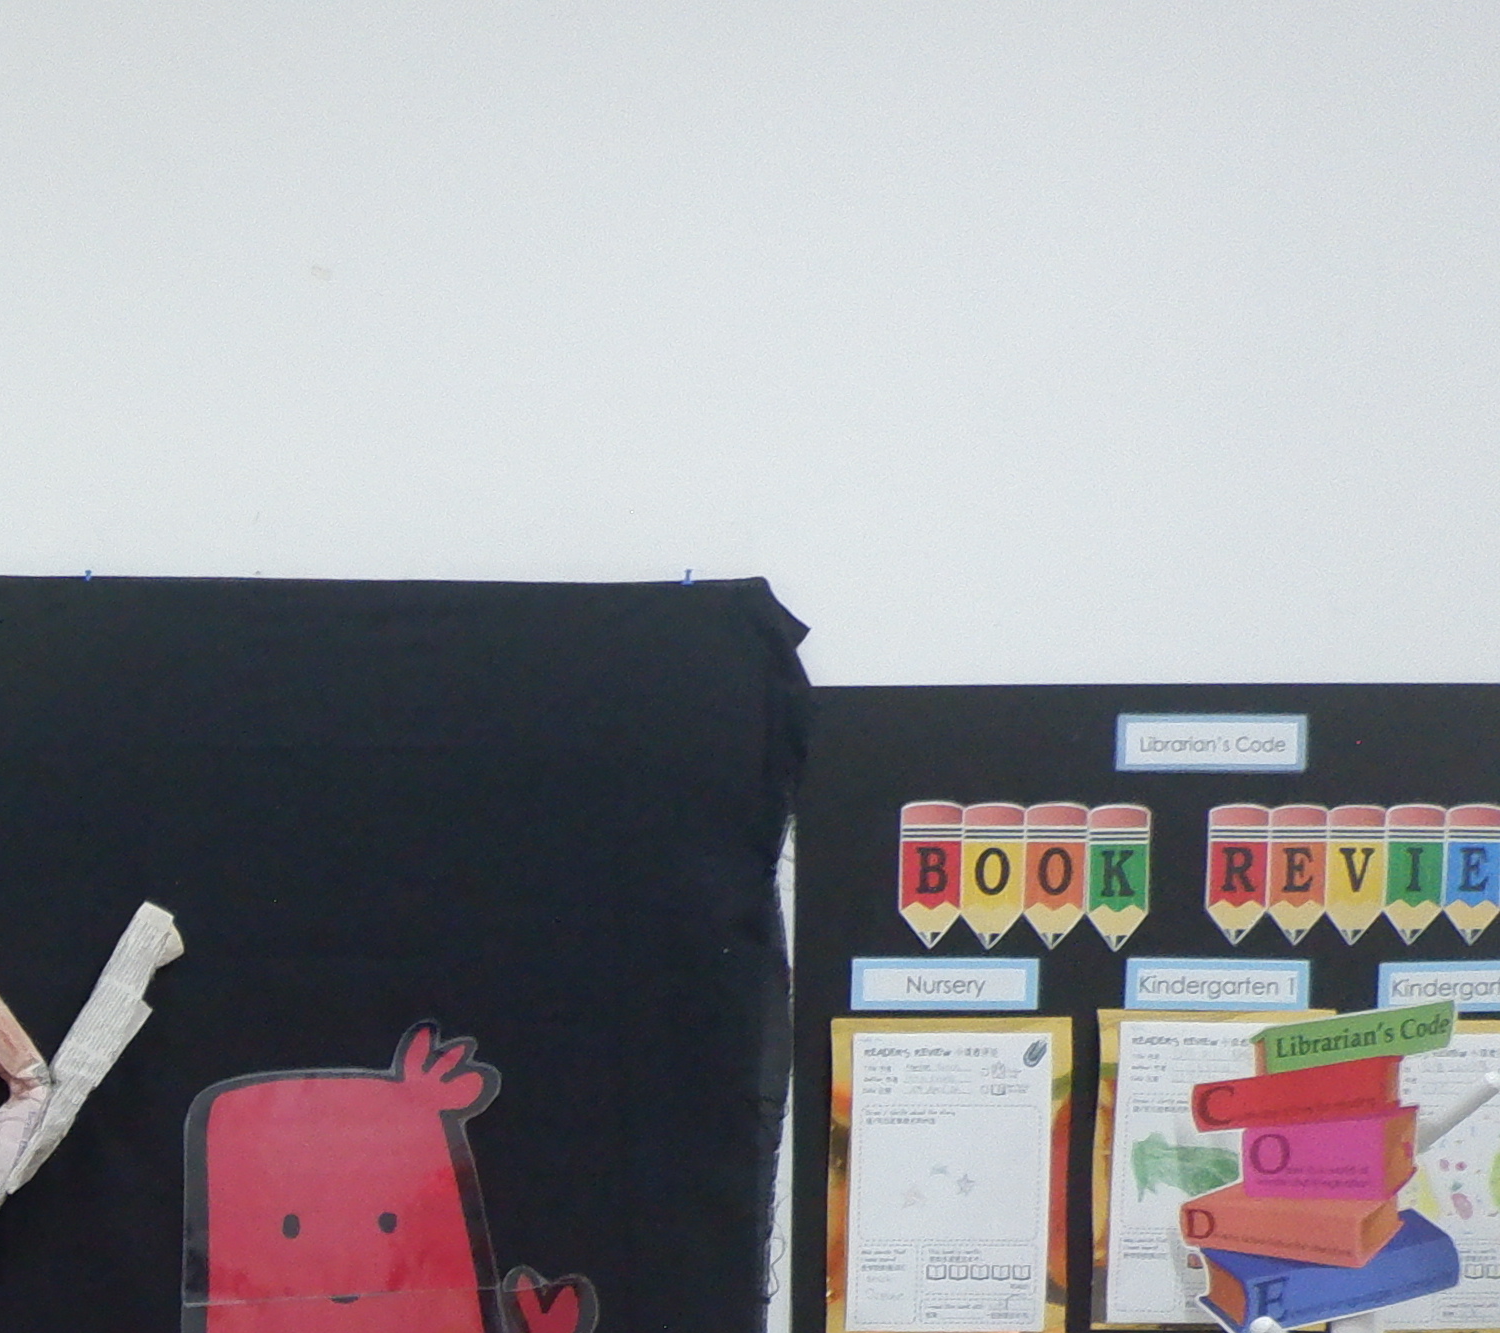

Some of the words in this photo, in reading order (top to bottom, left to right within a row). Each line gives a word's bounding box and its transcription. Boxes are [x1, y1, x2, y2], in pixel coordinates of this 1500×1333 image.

[1139, 735, 1231, 755] Librarian's
[1236, 735, 1287, 755] Code
[916, 846, 1136, 899] BOOK
[1222, 846, 1500, 893] REVIE
[904, 974, 986, 1001] Nursery
[1138, 973, 1279, 998] Kindergarten
[1286, 976, 1296, 995] 1
[1276, 1022, 1394, 1058] Librarian's
[1400, 1014, 1450, 1040] Code
[1202, 1086, 1235, 1126] C
[1250, 1133, 1290, 1174] O
[1187, 1209, 1215, 1239] D
[1254, 1277, 1289, 1322] E
